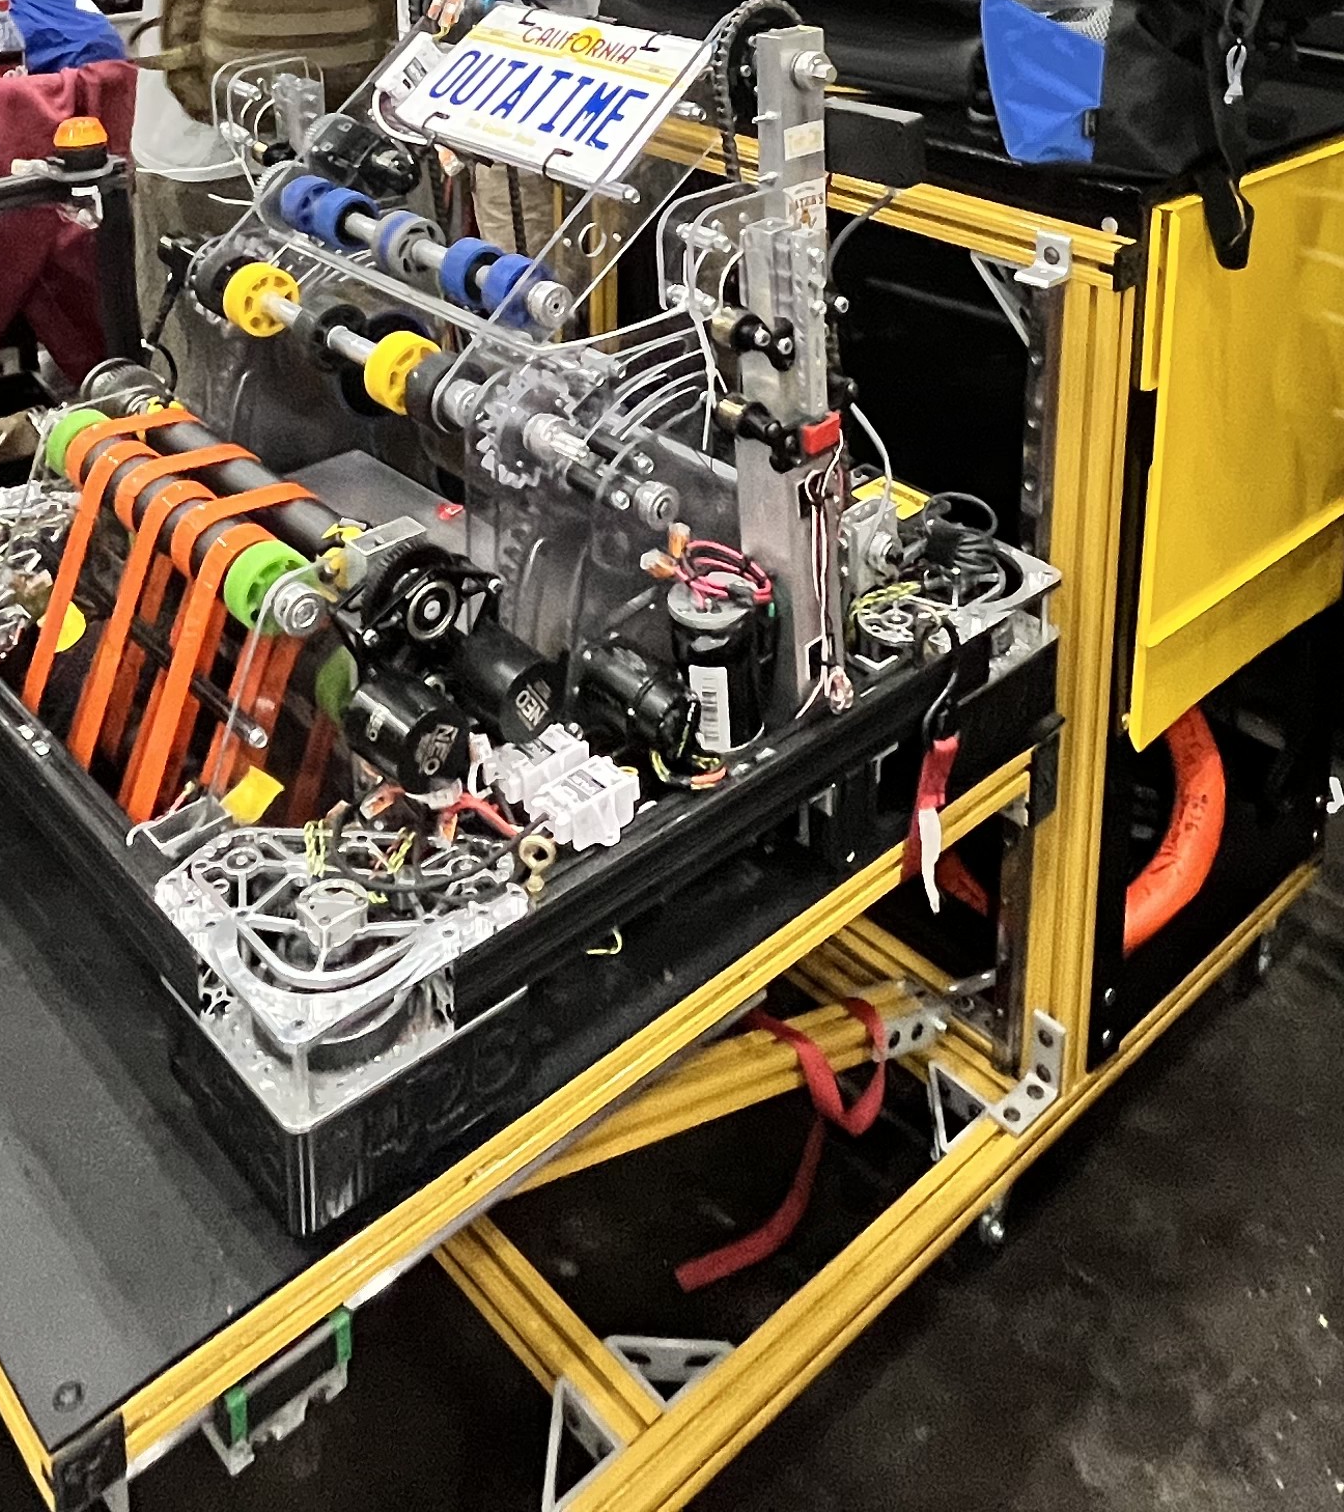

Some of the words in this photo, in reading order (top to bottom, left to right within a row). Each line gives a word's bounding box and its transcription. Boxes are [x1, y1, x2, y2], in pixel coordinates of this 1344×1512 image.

[522, 26, 638, 65] CALIFORNIA
[428, 49, 650, 151] OUTATIME
[515, 689, 547, 727] NEO
[422, 724, 459, 777] NEO
